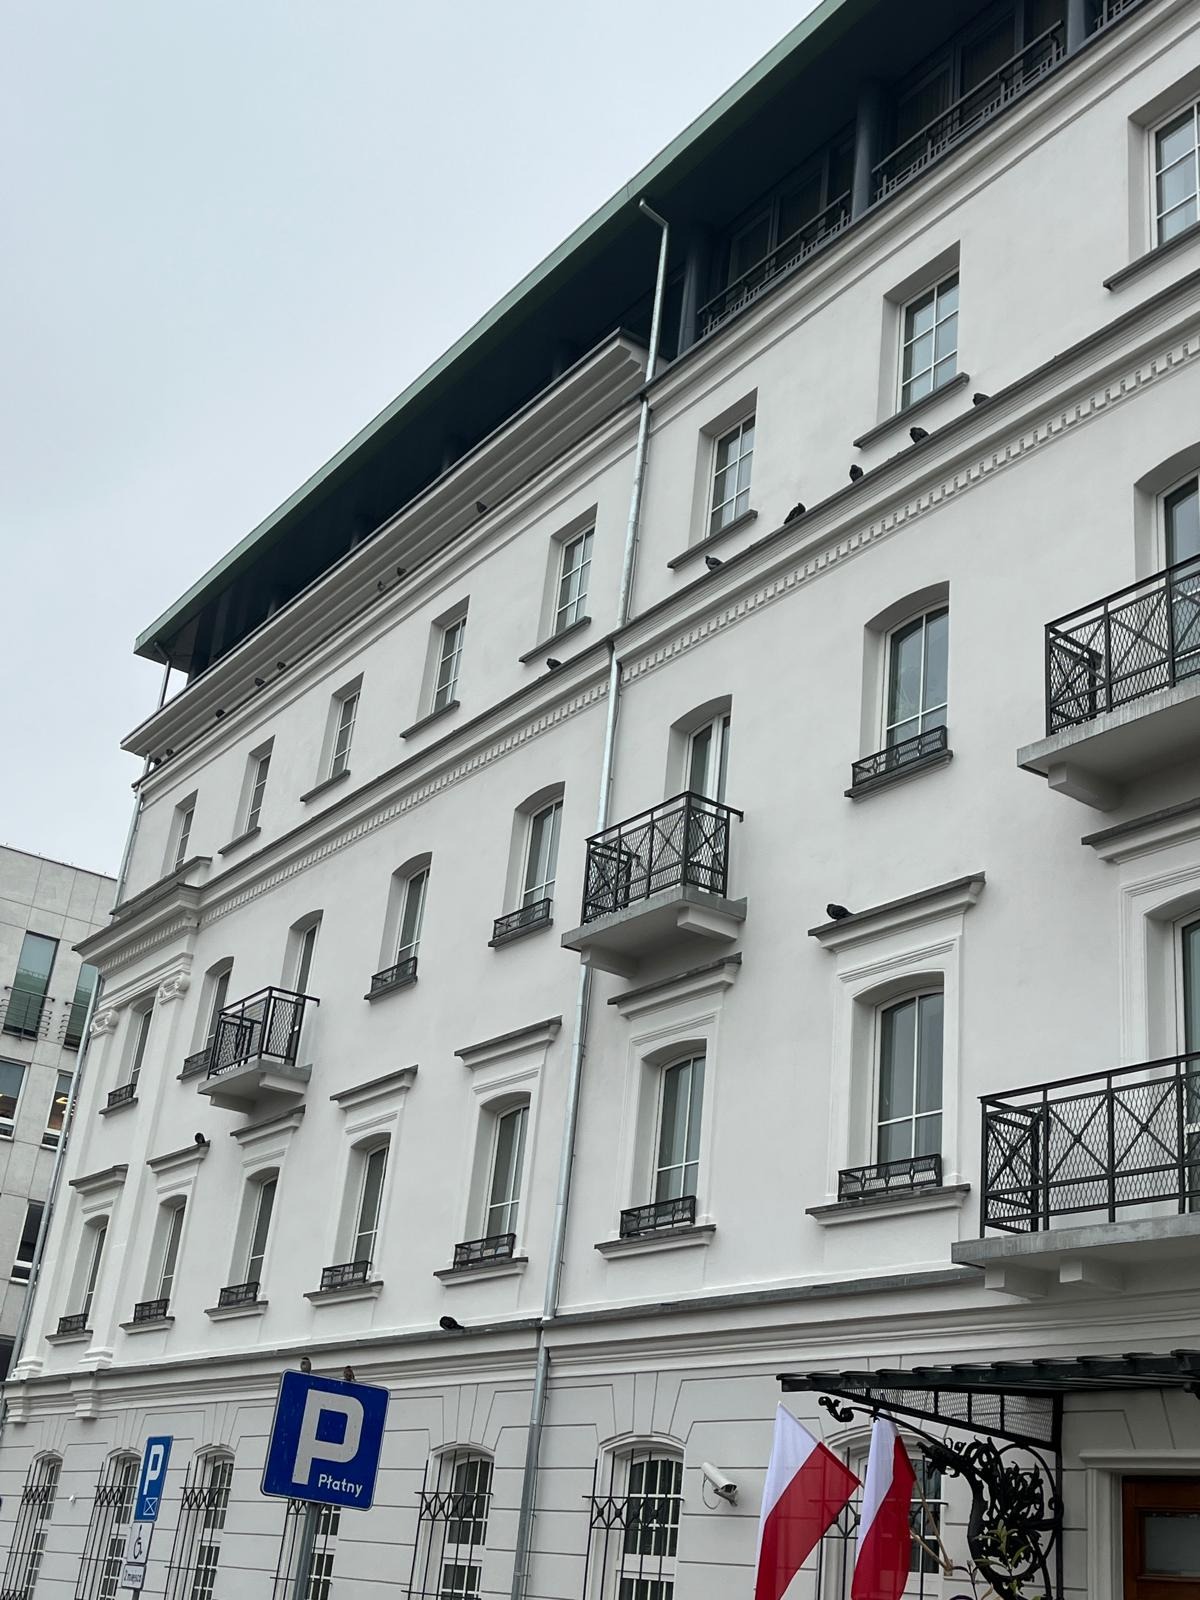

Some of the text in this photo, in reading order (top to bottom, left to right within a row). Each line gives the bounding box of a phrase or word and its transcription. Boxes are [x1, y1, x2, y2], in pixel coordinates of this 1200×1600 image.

[291, 1388, 365, 1486] P
[142, 1444, 165, 1496] P
[317, 1473, 363, 1498] Płatny
